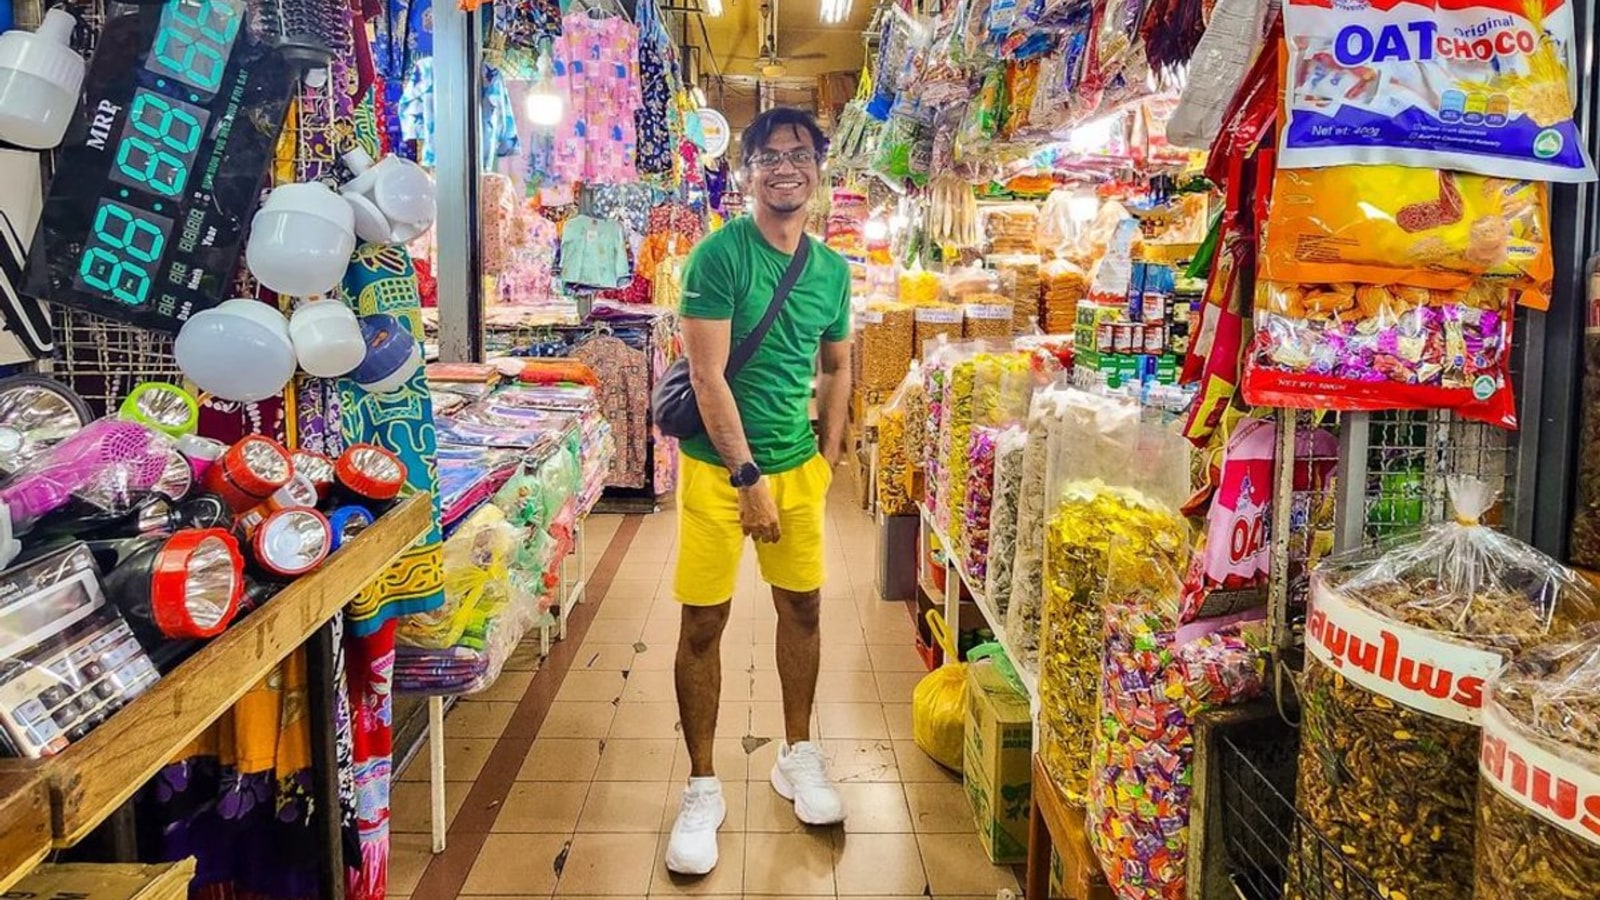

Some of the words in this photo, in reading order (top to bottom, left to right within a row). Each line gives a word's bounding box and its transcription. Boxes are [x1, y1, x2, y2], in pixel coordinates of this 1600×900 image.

[1335, 21, 1438, 66] OAT
[1436, 30, 1534, 61] CHOCO
[1454, 16, 1515, 38] Original
[86, 98, 120, 151] MRP
[177, 300, 192, 321] Date
[202, 226, 218, 248] Year
[1231, 514, 1266, 562] OA
